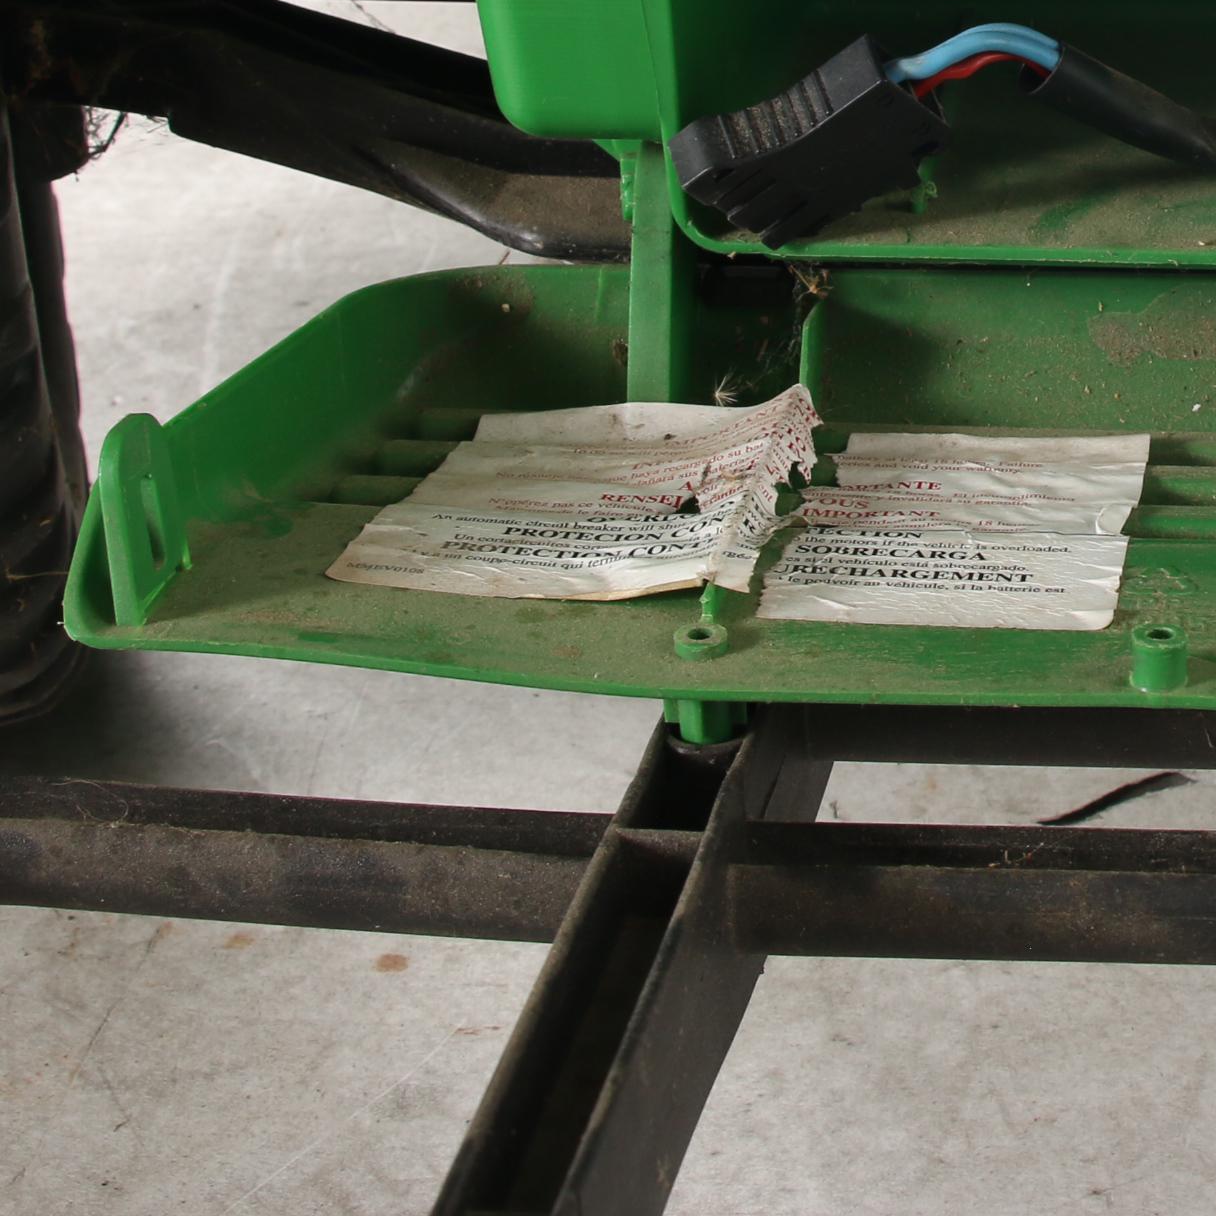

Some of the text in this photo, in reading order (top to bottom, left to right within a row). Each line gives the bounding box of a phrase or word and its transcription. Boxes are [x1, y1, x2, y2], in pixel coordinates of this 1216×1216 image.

[802, 508, 942, 519] IMPORTANT
[456, 515, 522, 526] automatic
[526, 520, 569, 529] circuit
[573, 522, 625, 532] breaker
[629, 522, 655, 532] will
[795, 544, 987, 561] SOBRECARGA
[804, 536, 827, 544] the
[830, 538, 878, 547] motors
[991, 544, 1072, 553] overloaded.
[465, 554, 557, 568] coupe-circuit
[561, 560, 584, 570] qui
[953, 583, 966, 591] si
